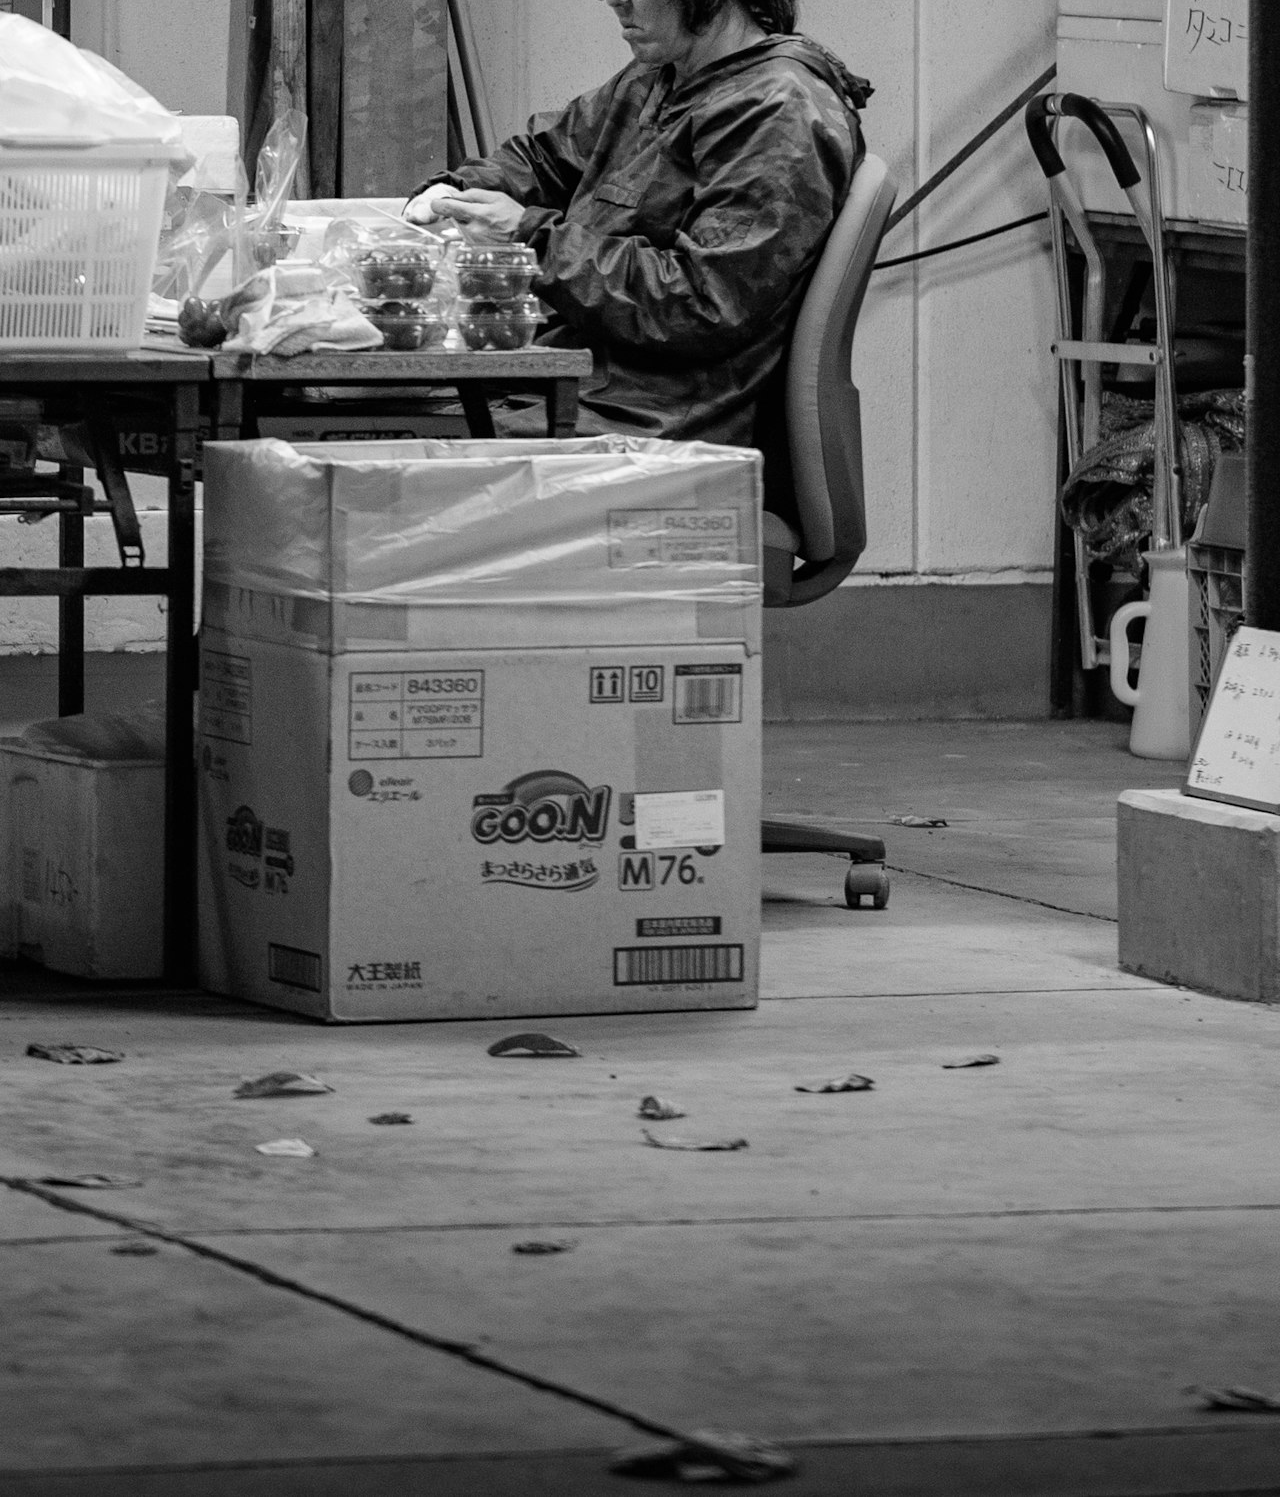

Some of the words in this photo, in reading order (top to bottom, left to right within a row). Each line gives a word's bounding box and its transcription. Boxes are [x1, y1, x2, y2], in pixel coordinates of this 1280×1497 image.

[407, 677, 479, 694] 843360
[633, 670, 658, 691] 10
[347, 961, 422, 982] 大王製紙
